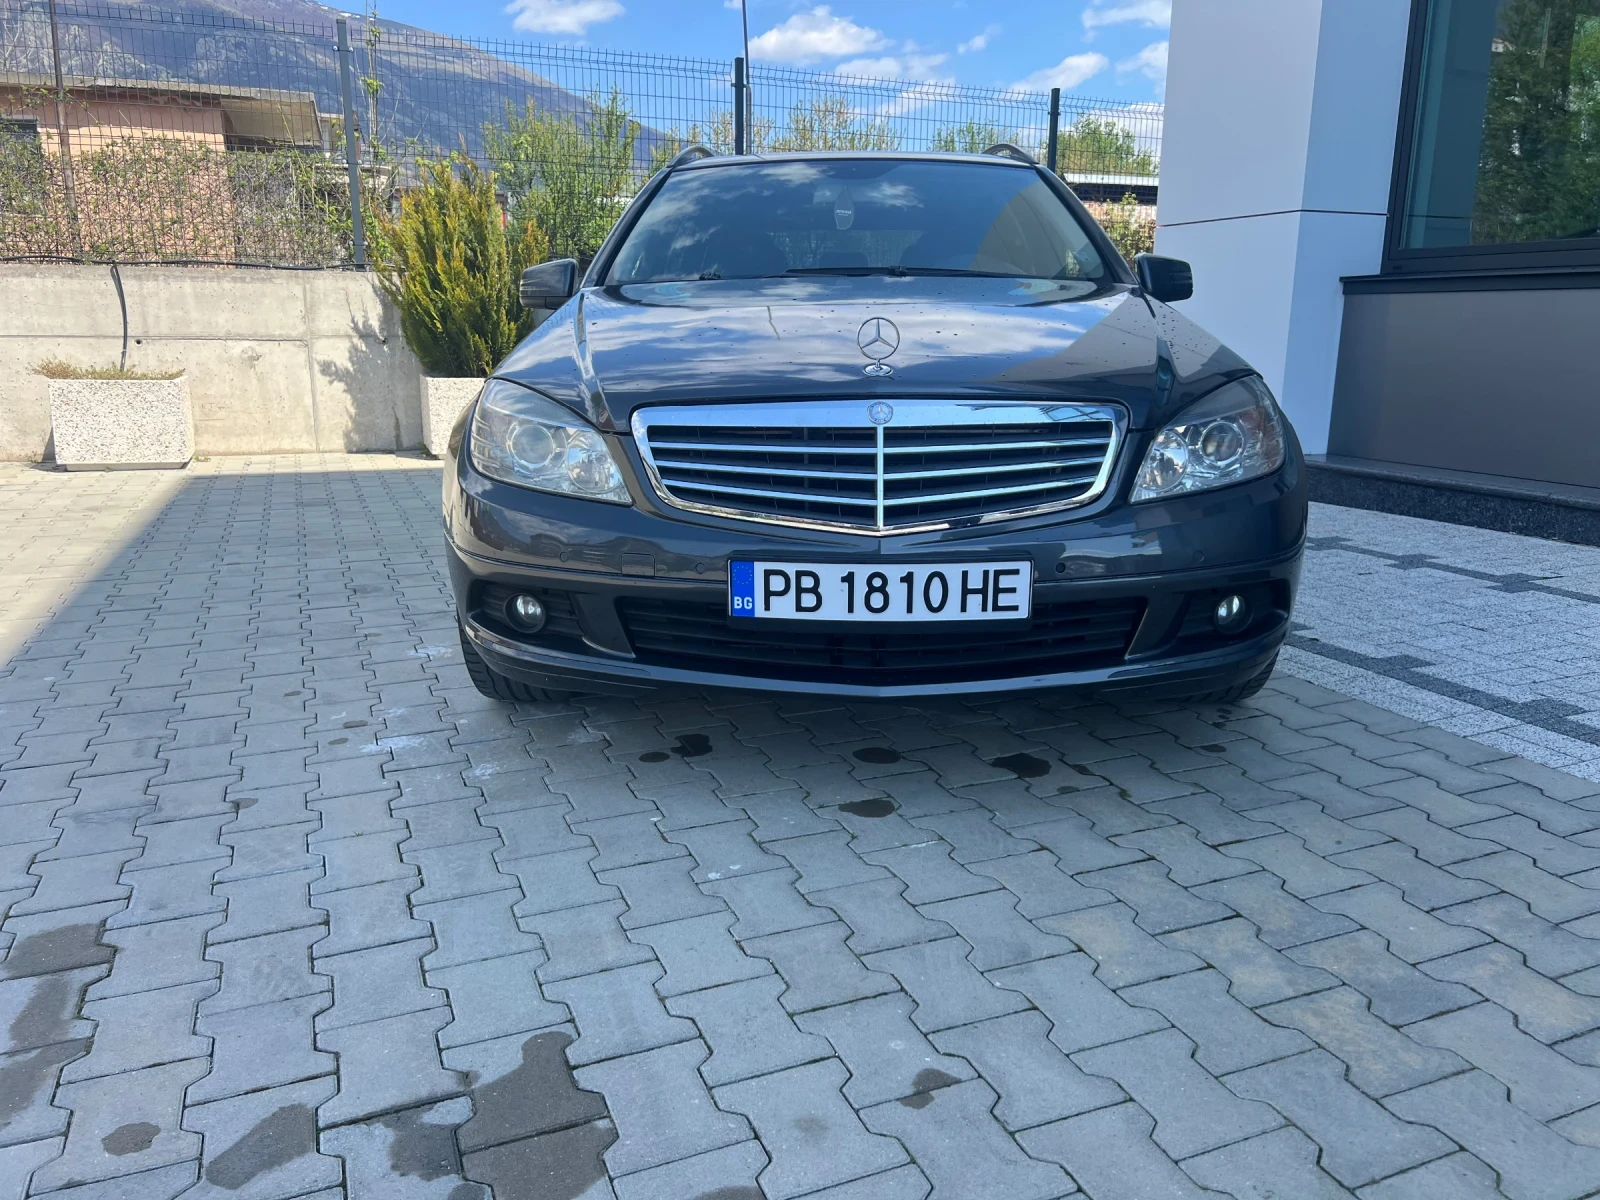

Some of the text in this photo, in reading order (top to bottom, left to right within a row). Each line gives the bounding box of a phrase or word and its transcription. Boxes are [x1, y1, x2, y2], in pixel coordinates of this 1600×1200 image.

[734, 596, 753, 610] BG
[763, 568, 1021, 614] PB 1810 HE
